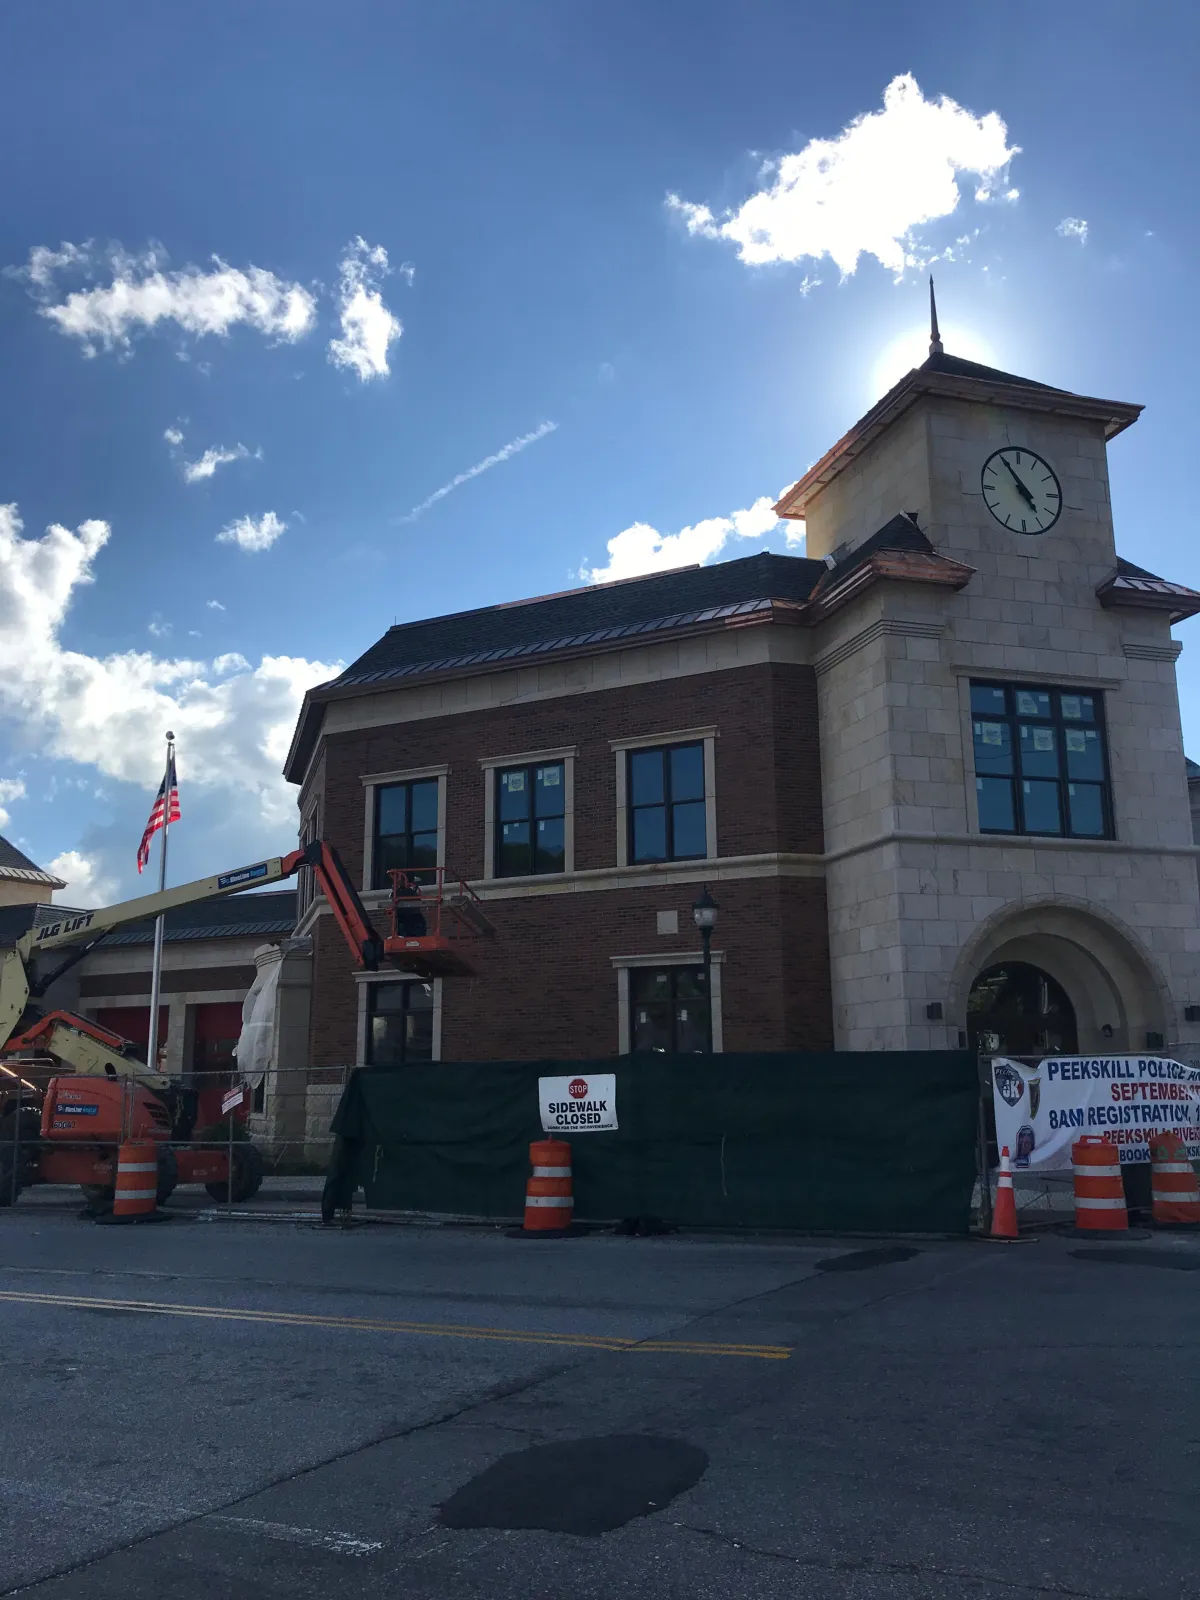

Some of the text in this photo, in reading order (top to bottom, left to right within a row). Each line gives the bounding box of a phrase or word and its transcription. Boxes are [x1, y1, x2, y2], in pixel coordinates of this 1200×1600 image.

[36, 913, 94, 941] JLG LIFT
[1047, 1060, 1135, 1081] PEEKSKILL
[1138, 1059, 1186, 1080] POLICE
[569, 1085, 588, 1094] STOP
[548, 1100, 607, 1114] SIDEWALK
[556, 1113, 601, 1125] CLOSED
[1049, 1107, 1085, 1129] 8AM
